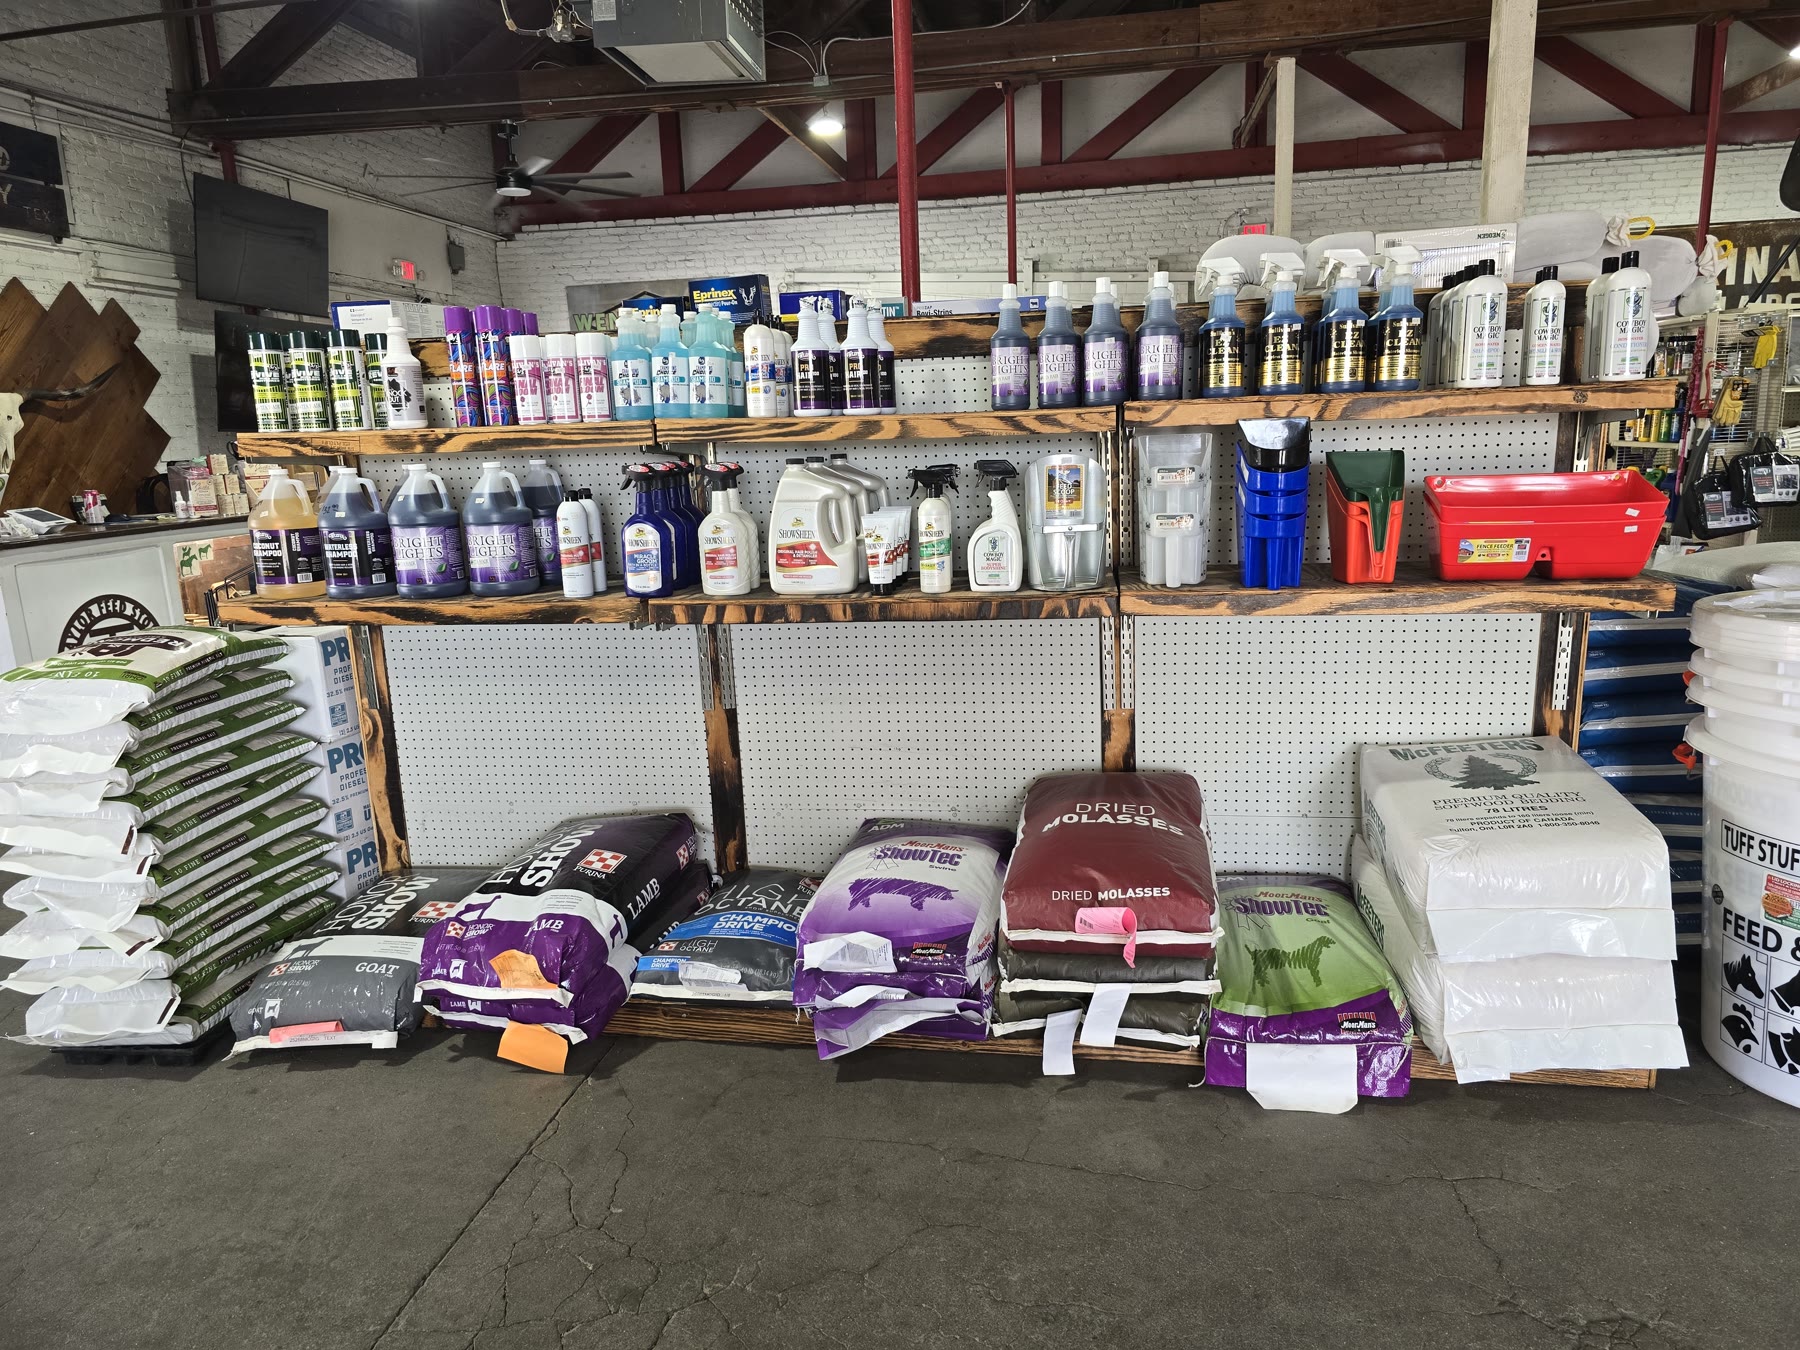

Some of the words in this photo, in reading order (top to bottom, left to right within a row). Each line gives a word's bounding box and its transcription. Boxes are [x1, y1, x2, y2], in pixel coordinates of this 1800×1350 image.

[693, 288, 737, 302] Eprinex
[1616, 320, 1646, 328] COBOY
[1386, 338, 1420, 347] CLEAN
[468, 534, 516, 546] BRIGHT
[778, 529, 815, 539] SHOWSHEEN
[393, 536, 442, 548] BRIGHT
[395, 546, 443, 558] LIGHTS
[470, 545, 517, 557] LIGHTS
[100, 598, 126, 612] FEED
[326, 689, 343, 698] 32.5%
[157, 709, 173, 720] FINE
[175, 702, 193, 711] PREMIUM
[151, 750, 167, 760] FINE
[170, 742, 188, 751] PREMIUM
[190, 736, 207, 745] MINERAL
[1388, 738, 1545, 761] McFEETERS
[163, 785, 180, 796] FINE
[182, 776, 201, 787] PREMIUM
[201, 769, 219, 779] MINERAL
[339, 778, 366, 792] DIESEL
[331, 797, 348, 805] 32.5%
[1432, 793, 1507, 805] PREMIUM
[1512, 791, 1581, 799] QUALITY
[1434, 799, 1514, 811] SOFTWOOD
[1521, 796, 1587, 804] BEDDING
[182, 818, 198, 830] FINE
[200, 809, 216, 819] PREMIUM
[217, 802, 232, 812] MINERAL
[1076, 802, 1156, 816] DRIED
[1502, 805, 1549, 813] LITRES
[868, 821, 905, 833] ADM
[1042, 814, 1184, 836] MOLASSES
[1723, 825, 1754, 857] TUFF
[184, 859, 201, 871] FINE
[203, 850, 221, 861] PREMIUM
[222, 841, 239, 852] MINERAL
[239, 835, 247, 843] SALT
[520, 823, 603, 888] SHOW
[573, 866, 607, 880] PURINA
[928, 864, 957, 872] Swine
[187, 898, 202, 910] FINE
[205, 887, 223, 898] PREMIUM
[224, 878, 240, 889] MINERAL
[241, 872, 250, 880] SALT
[1052, 890, 1093, 901] DRIED
[1097, 887, 1171, 901] MOLASSES
[351, 875, 439, 930] SHOW
[626, 877, 661, 920] LAMB
[694, 897, 807, 918] OCTANE
[1236, 897, 1330, 917] ShowTec
[212, 918, 230, 930] PREMIUM
[231, 910, 246, 921] MINERAL
[712, 921, 765, 931] DRIVE
[718, 913, 800, 933] CHAMPIO
[464, 929, 490, 939] SHOW
[468, 923, 495, 932] HONOR
[526, 919, 564, 938] LAMB
[1723, 907, 1783, 954] FEED
[679, 945, 714, 953] OCTANE
[288, 964, 317, 972] SHOW
[355, 962, 399, 974] GOAT
